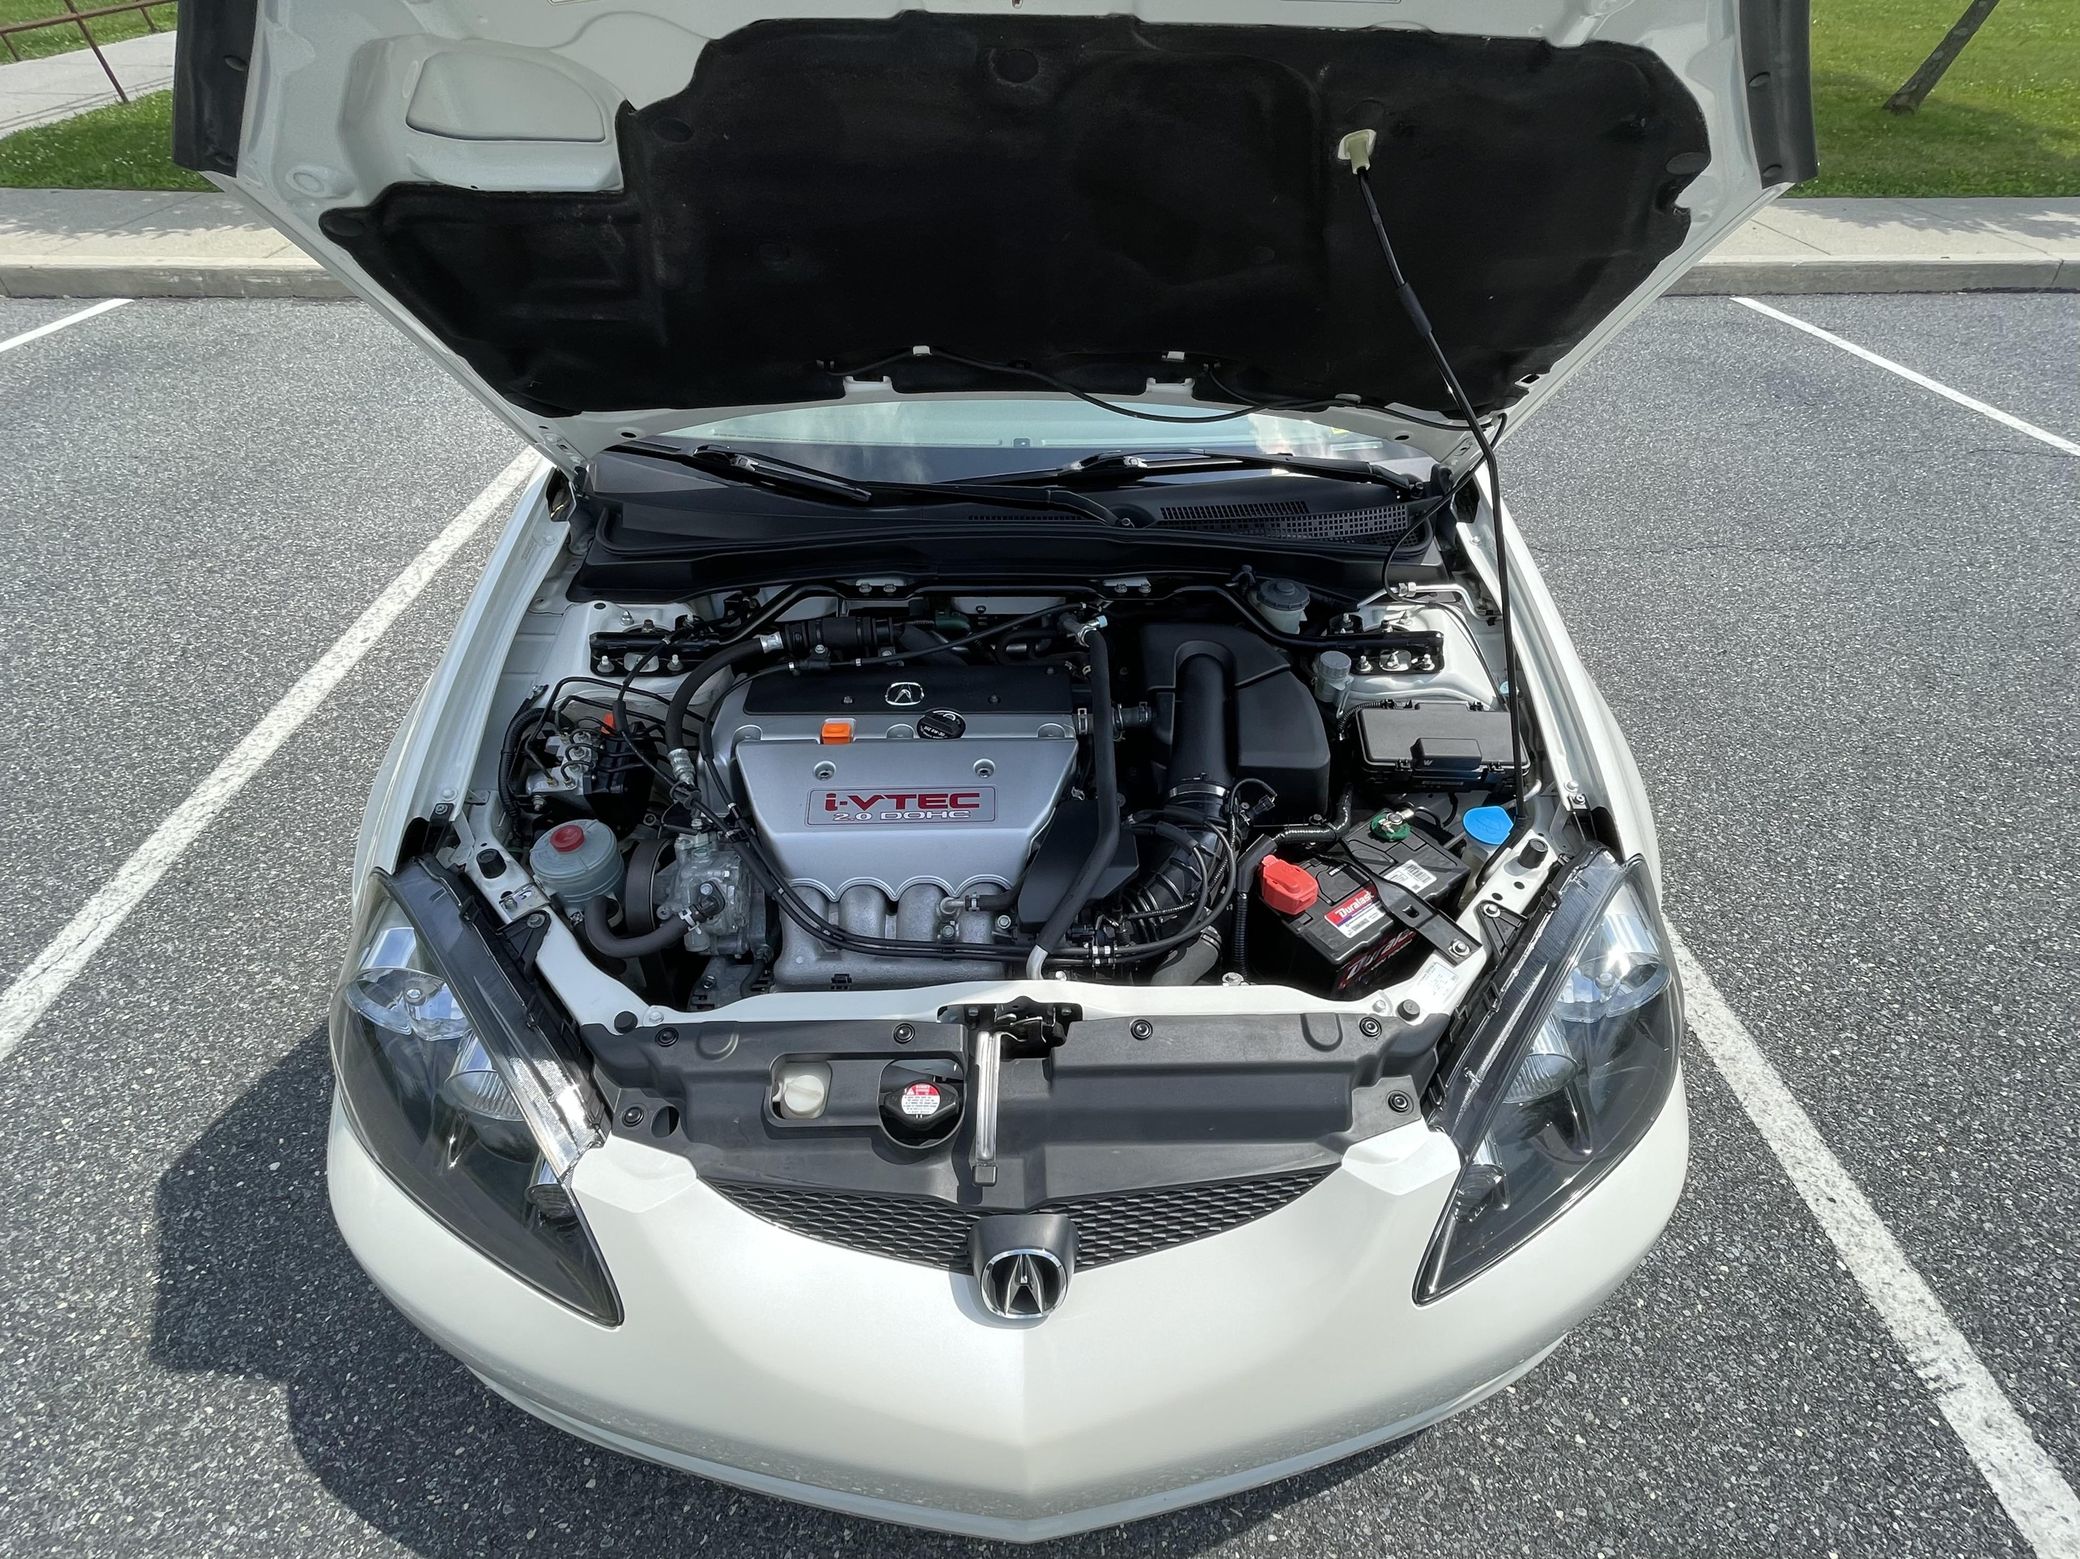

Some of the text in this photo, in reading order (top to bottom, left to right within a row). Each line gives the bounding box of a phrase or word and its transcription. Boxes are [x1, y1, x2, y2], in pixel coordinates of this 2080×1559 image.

[825, 792, 980, 811] i-VTEC
[833, 810, 971, 821] 2.0 DOHC
[1334, 889, 1375, 919] Duralast
